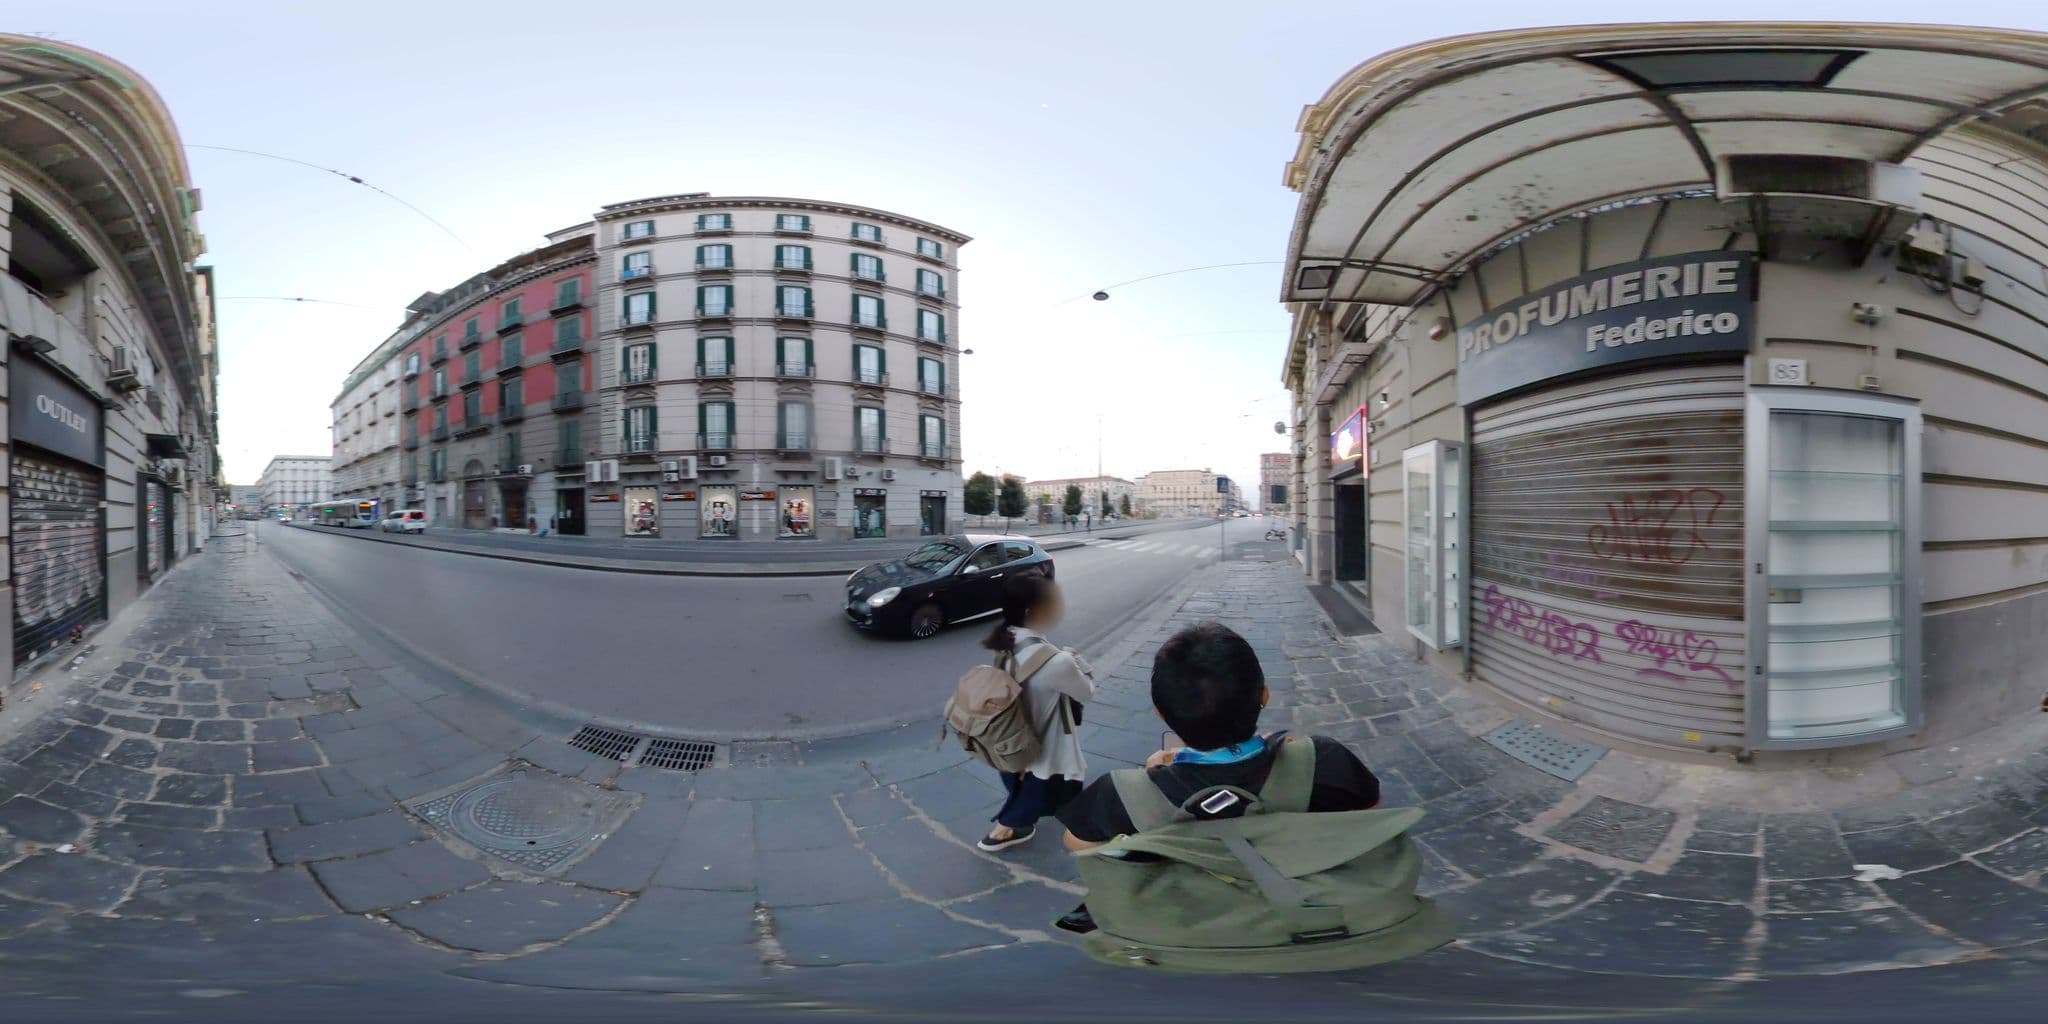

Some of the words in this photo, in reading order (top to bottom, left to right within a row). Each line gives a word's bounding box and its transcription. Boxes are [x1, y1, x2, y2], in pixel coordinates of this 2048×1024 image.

[1459, 260, 1740, 363] PROFUMERIE
[1586, 309, 1739, 352] Federico
[1773, 363, 1800, 381] 85
[37, 394, 87, 433] OUTLET
